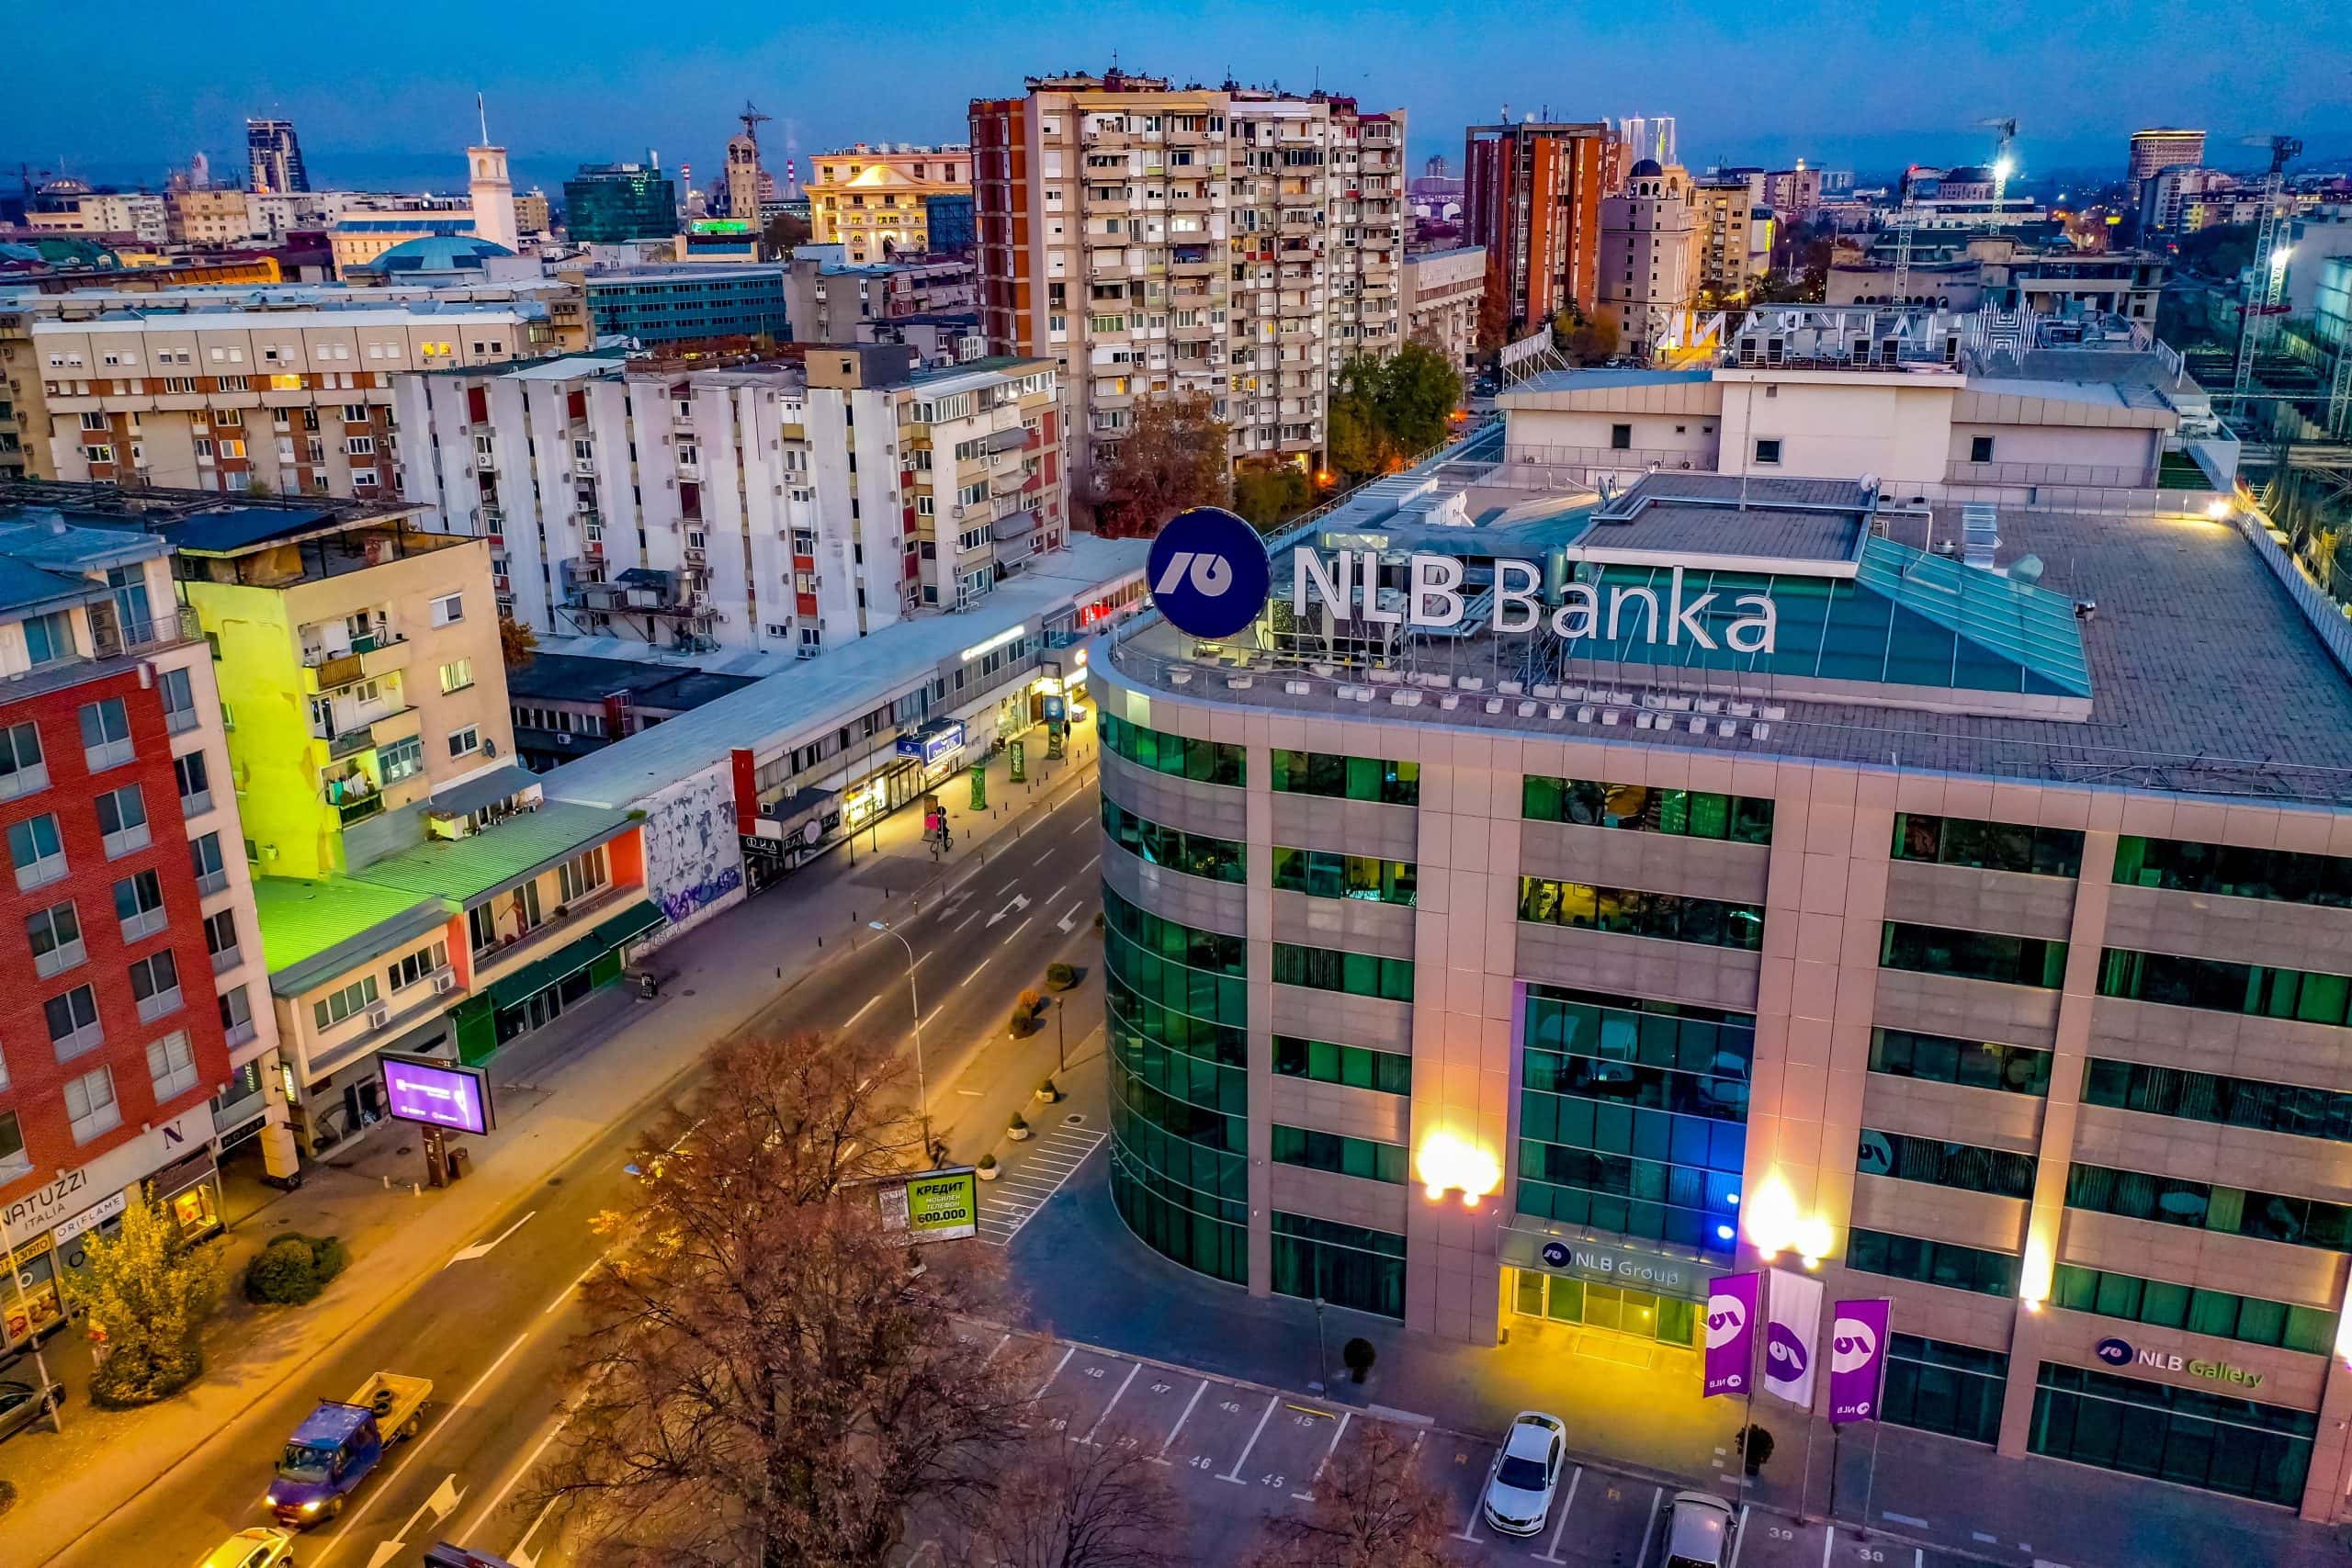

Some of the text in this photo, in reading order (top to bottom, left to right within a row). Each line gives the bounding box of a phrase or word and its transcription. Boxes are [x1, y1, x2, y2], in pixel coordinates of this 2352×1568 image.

[1294, 546, 1777, 654] NLB Banka
[163, 1121, 184, 1149] N
[917, 1181, 965, 1196] КРЕДИТ
[926, 1194, 961, 1203] МОБИЛЕН
[927, 1201, 960, 1211] ТЕЛЕФОН
[25, 1203, 66, 1231] ITALIA
[57, 1197, 120, 1237] ORIFLAME
[918, 1209, 966, 1224] 600.000
[1576, 1252, 1679, 1286] NLB Group
[2139, 1349, 2264, 1388] NLB Gallery
[1150, 1383, 1171, 1394] 47
[1219, 1400, 1241, 1413] 46
[1294, 1416, 1316, 1427] 45
[1189, 1455, 1212, 1470] 46
[1261, 1473, 1285, 1488] 45
[1769, 1527, 1793, 1541] 39
[1860, 1549, 1883, 1562] 38
